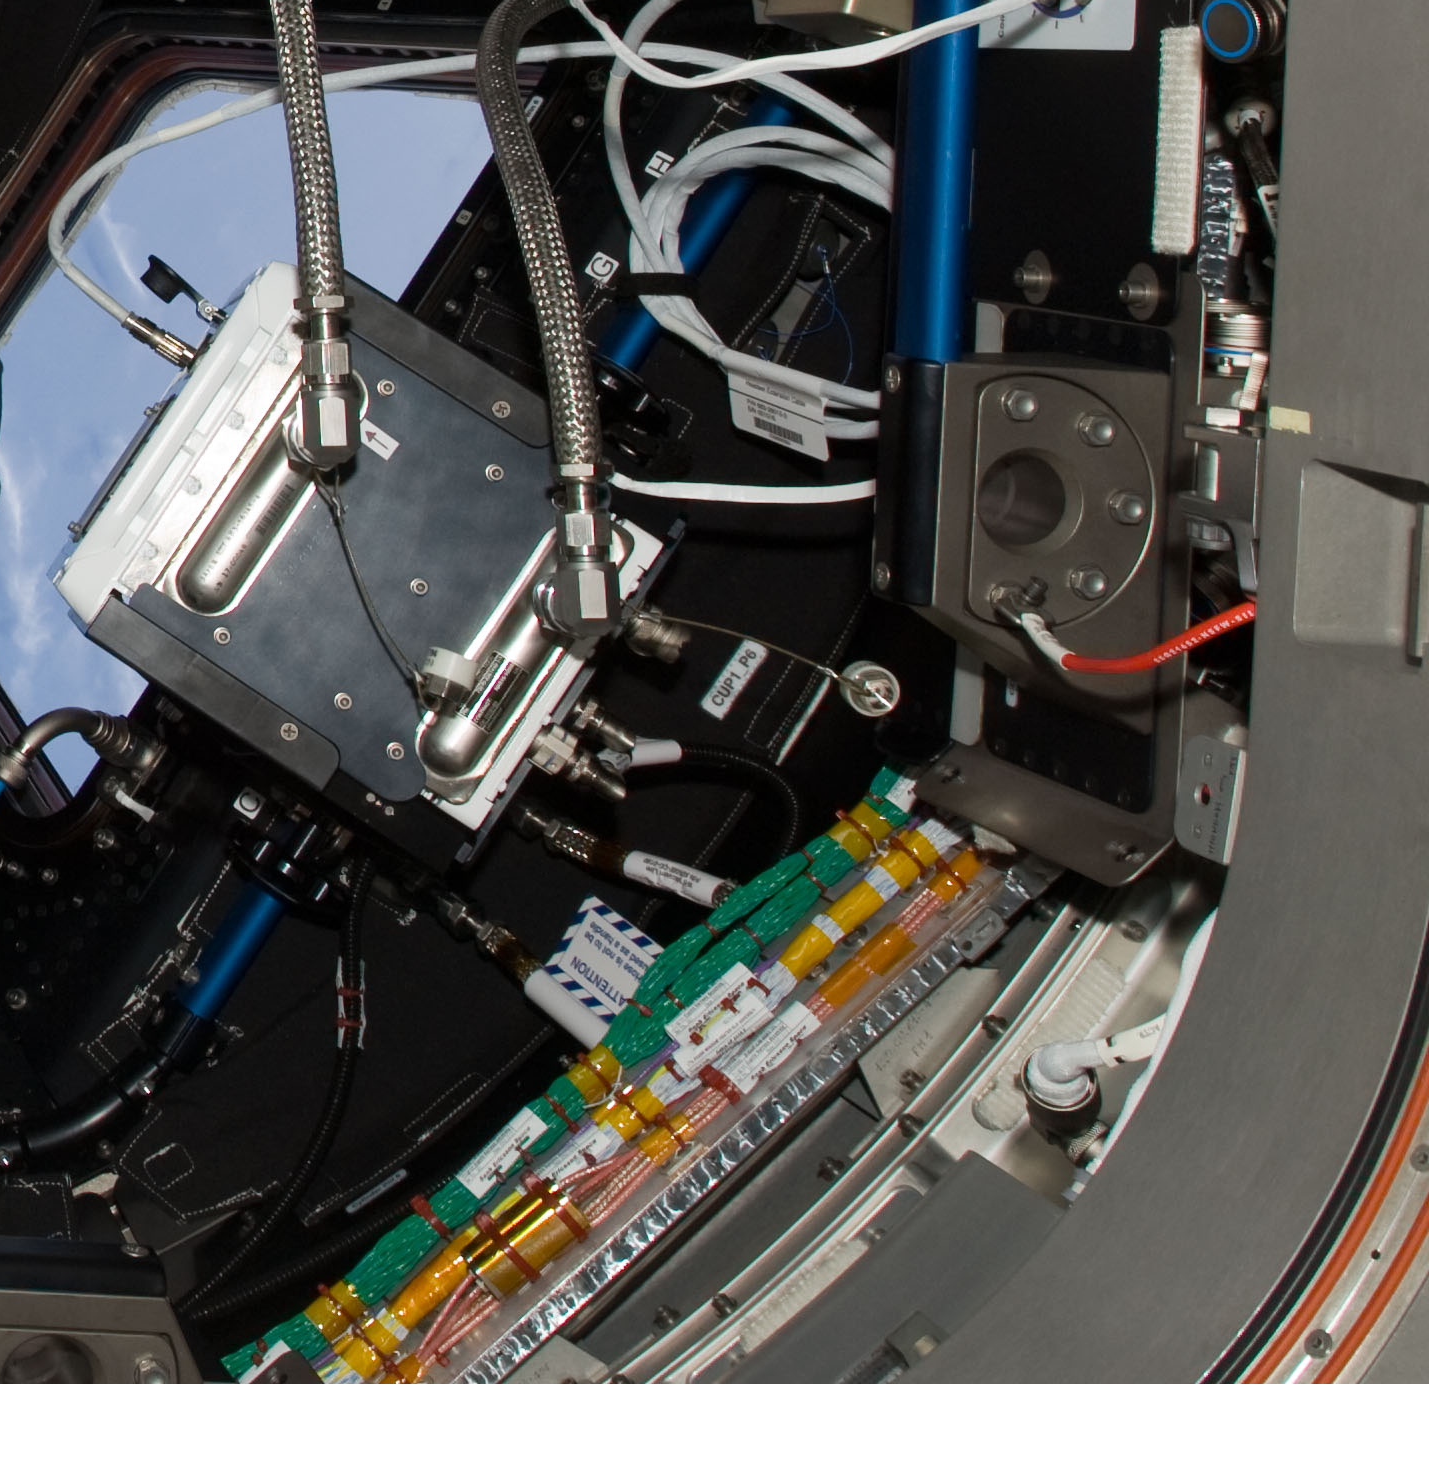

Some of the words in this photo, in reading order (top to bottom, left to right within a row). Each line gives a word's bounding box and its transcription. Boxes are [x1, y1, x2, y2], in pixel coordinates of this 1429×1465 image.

[648, 155, 671, 176] H
[590, 257, 614, 278] G
[711, 649, 757, 707] CUP1_P6
[240, 796, 258, 812] C
[583, 931, 595, 942] be
[589, 921, 614, 944] handle
[602, 945, 617, 960] not
[571, 956, 627, 1007] ATTENTION
